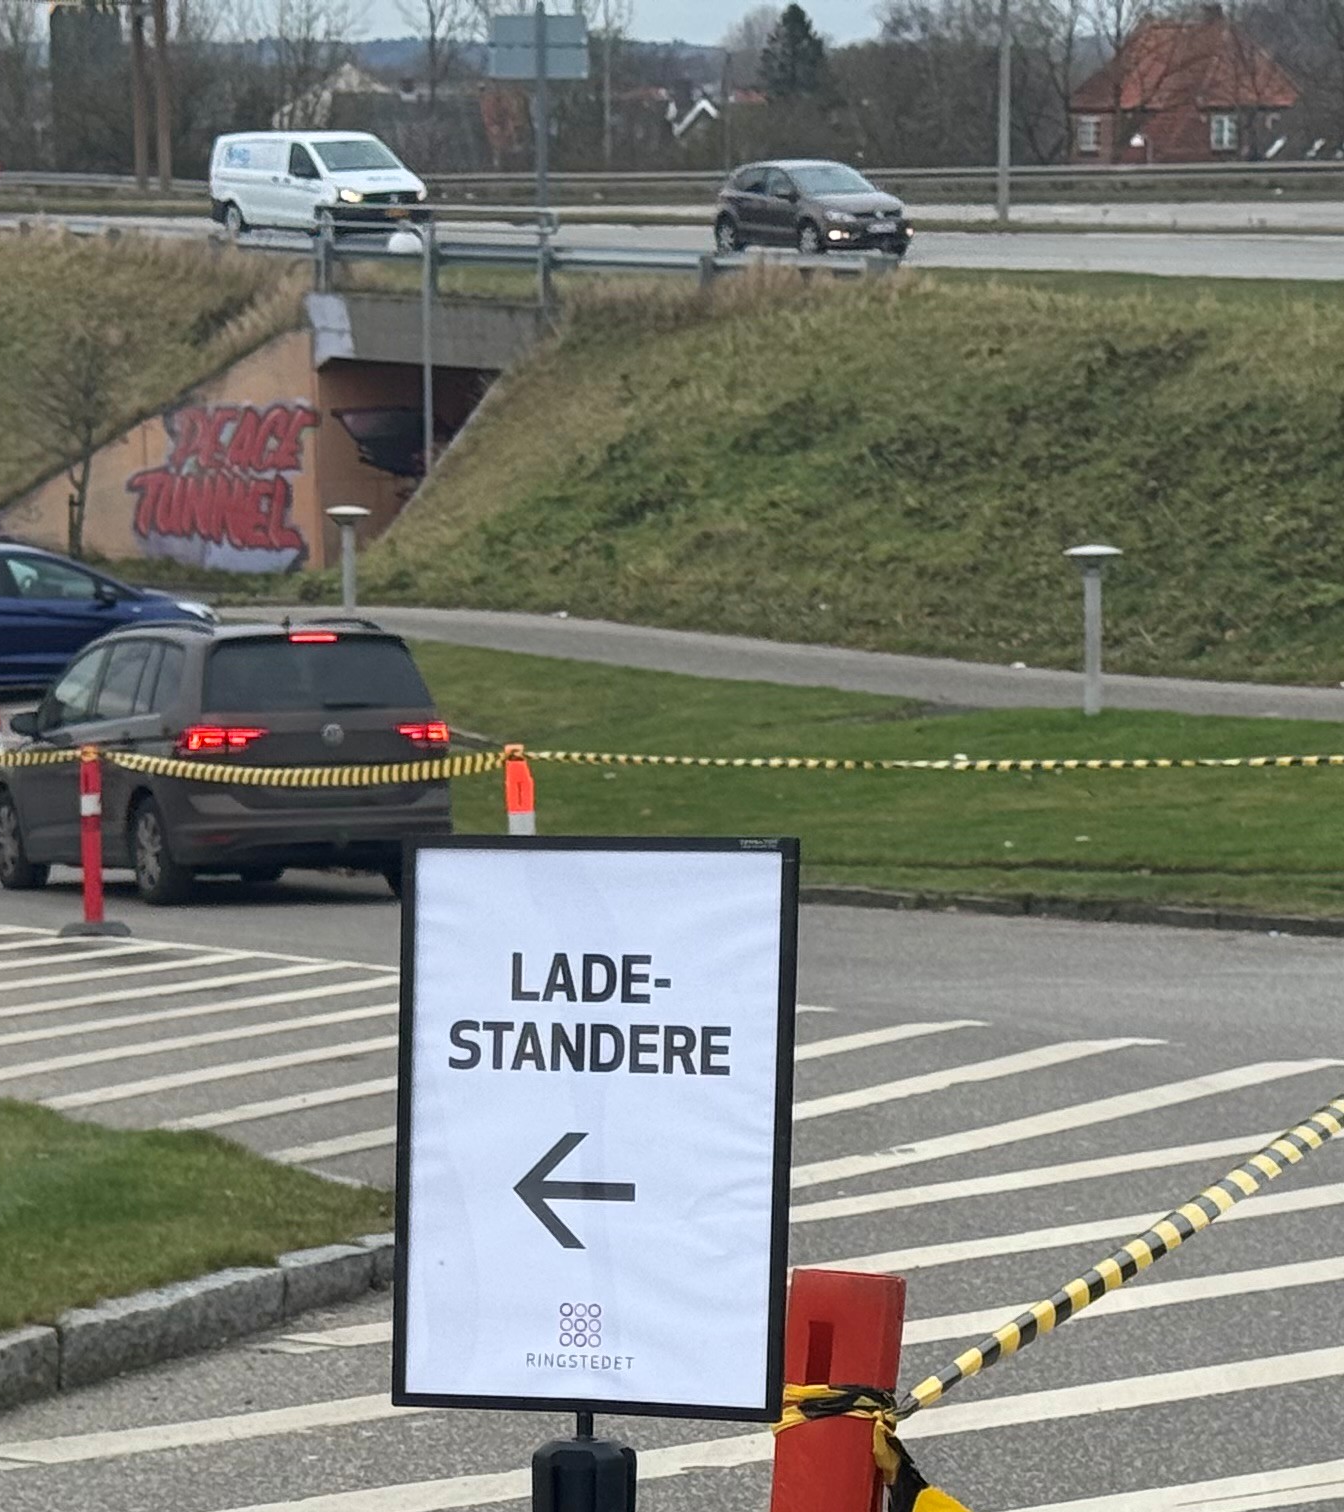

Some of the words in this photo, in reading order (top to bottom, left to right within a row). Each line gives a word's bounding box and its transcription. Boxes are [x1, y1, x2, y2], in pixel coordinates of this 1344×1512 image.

[169, 404, 319, 471] PEACE
[128, 469, 305, 550] TUNNEL
[511, 951, 672, 1004] LADE-
[448, 1019, 732, 1076] STANDERE
[525, 1352, 636, 1370] RINGSTEDET
